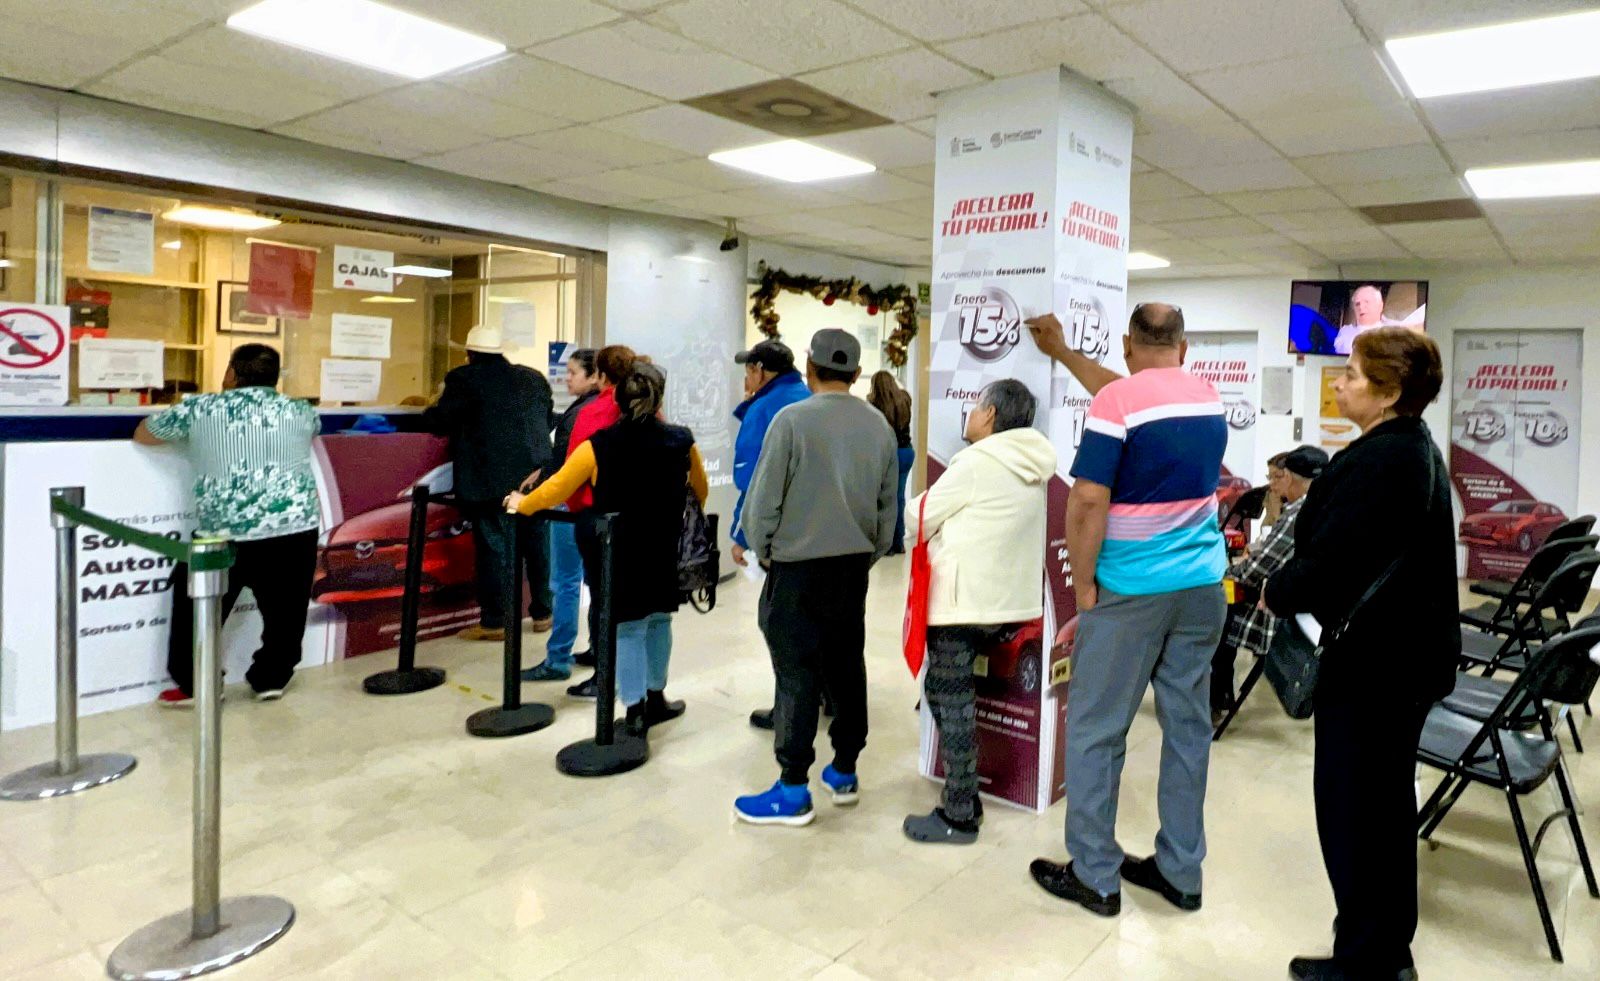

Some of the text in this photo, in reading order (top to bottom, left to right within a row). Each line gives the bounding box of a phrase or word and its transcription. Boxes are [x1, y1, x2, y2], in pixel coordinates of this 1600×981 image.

[952, 192, 1034, 219] ¡ACELERA
[942, 211, 1047, 236] TU PREDIAL!
[1062, 218, 1076, 236] TU
[338, 263, 389, 278] CAJAS
[996, 266, 1046, 276] descuentos
[954, 293, 987, 305] Enero
[1070, 298, 1091, 312] Enero
[960, 305, 1020, 346] 15%
[1073, 312, 1110, 355] 15%
[1467, 378, 1487, 389] TU
[945, 387, 982, 400] Febrer
[1063, 395, 1091, 407] Febrero
[1466, 415, 1568, 441] 15% 10%
[81, 578, 173, 603] MAZD
[79, 617, 168, 637] Sorteo 9 de
